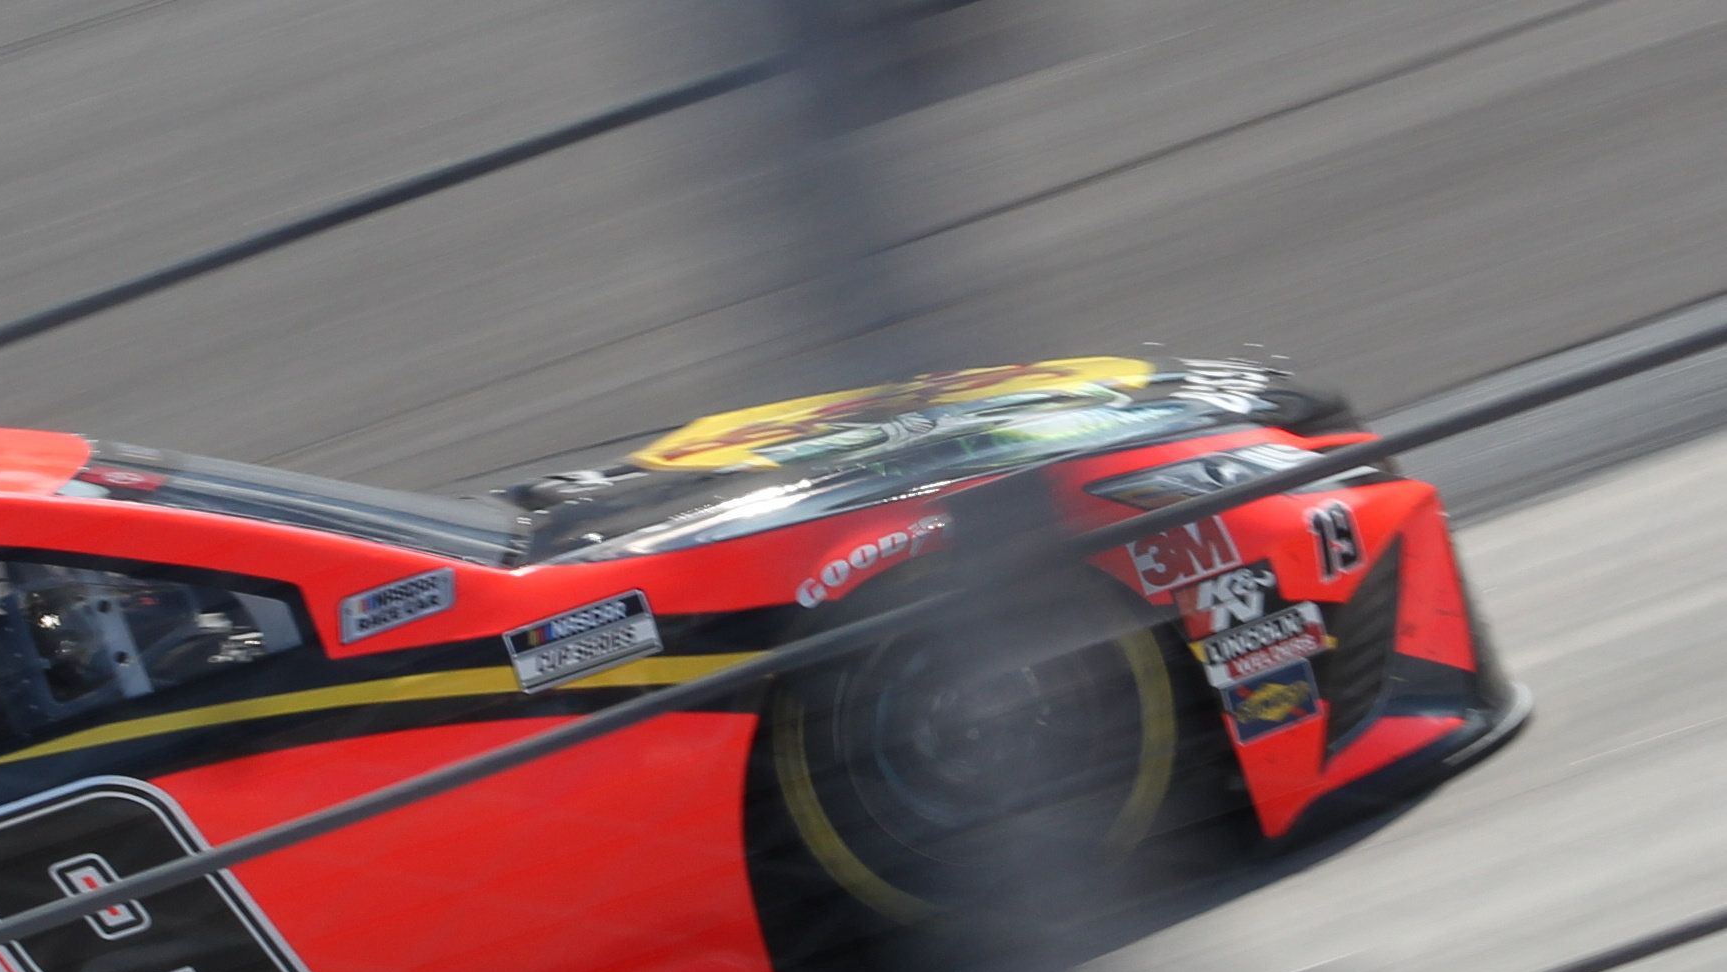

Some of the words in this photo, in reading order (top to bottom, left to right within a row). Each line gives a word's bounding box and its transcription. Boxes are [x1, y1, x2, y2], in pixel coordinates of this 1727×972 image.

[1132, 516, 1236, 587] 3M
[1307, 503, 1366, 583] 19
[1197, 567, 1276, 631] K&N
